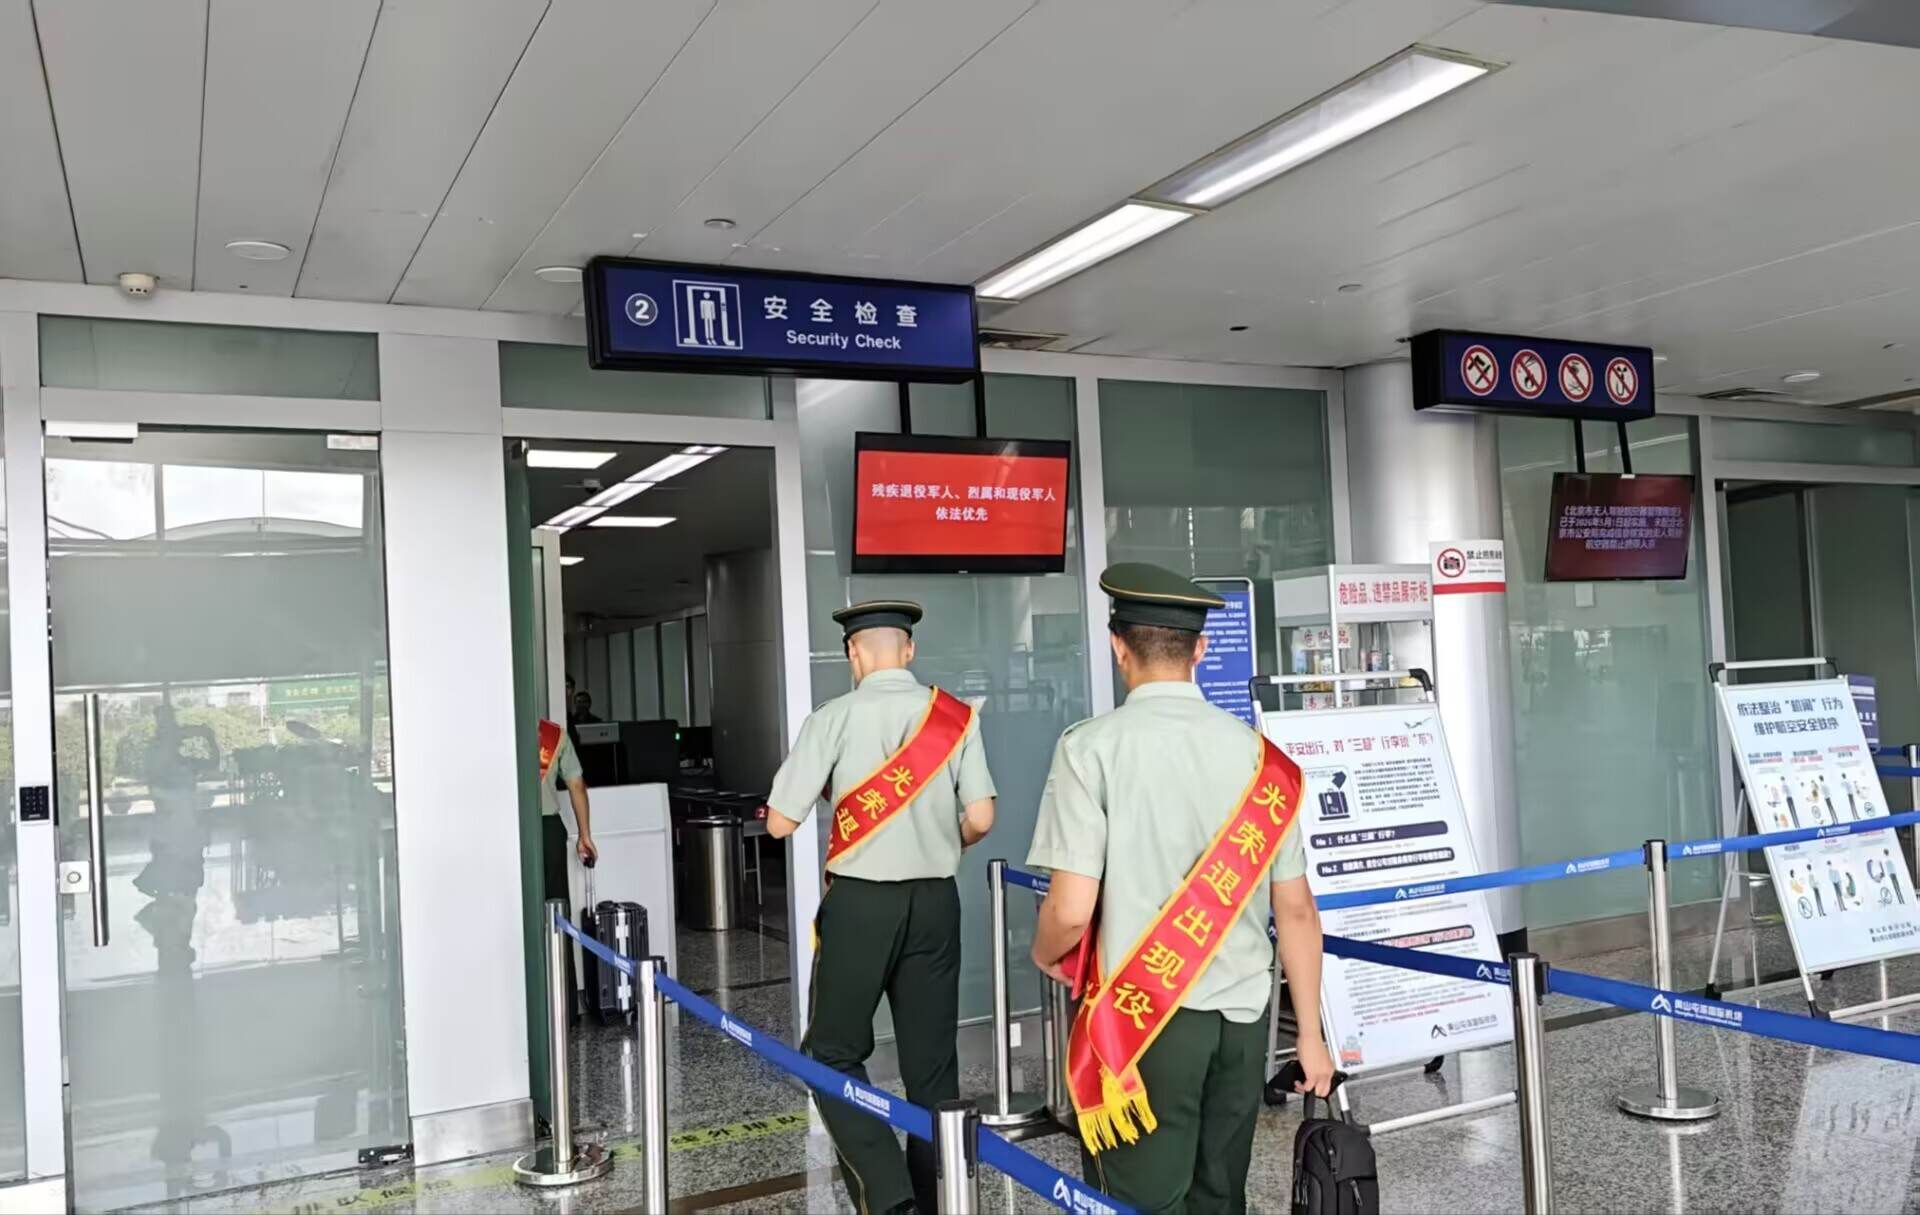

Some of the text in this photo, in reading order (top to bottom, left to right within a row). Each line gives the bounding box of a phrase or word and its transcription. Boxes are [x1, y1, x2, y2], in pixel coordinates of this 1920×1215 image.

[763, 296, 918, 328] 安全检查
[786, 329, 902, 350] Security Check
[871, 483, 1057, 502] 残疾退役军人、烈属和现役军人
[935, 506, 988, 521] 依法优先
[828, 765, 914, 849] 光荣退
[1112, 781, 1287, 1031] 光荣退出现役
